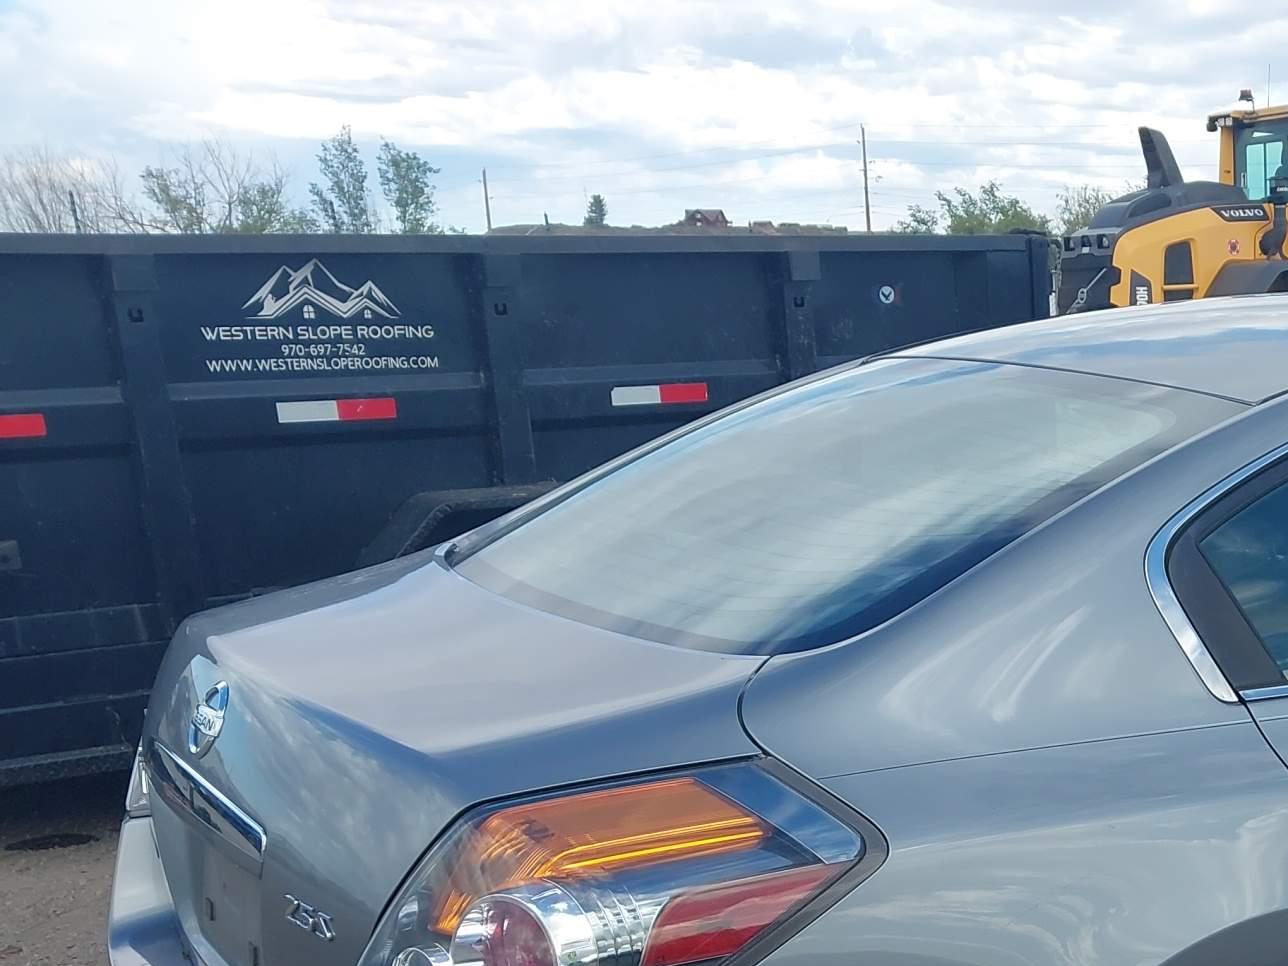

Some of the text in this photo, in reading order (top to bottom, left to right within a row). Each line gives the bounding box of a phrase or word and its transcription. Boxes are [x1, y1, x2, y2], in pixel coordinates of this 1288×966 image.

[1220, 207, 1264, 217] VOLVO
[200, 325, 434, 341] WESTERN SLOPE ROOFING
[280, 343, 366, 356] 970-697-7542
[206, 356, 439, 373] WWW.WESTERNSLOPEROOFING.COM
